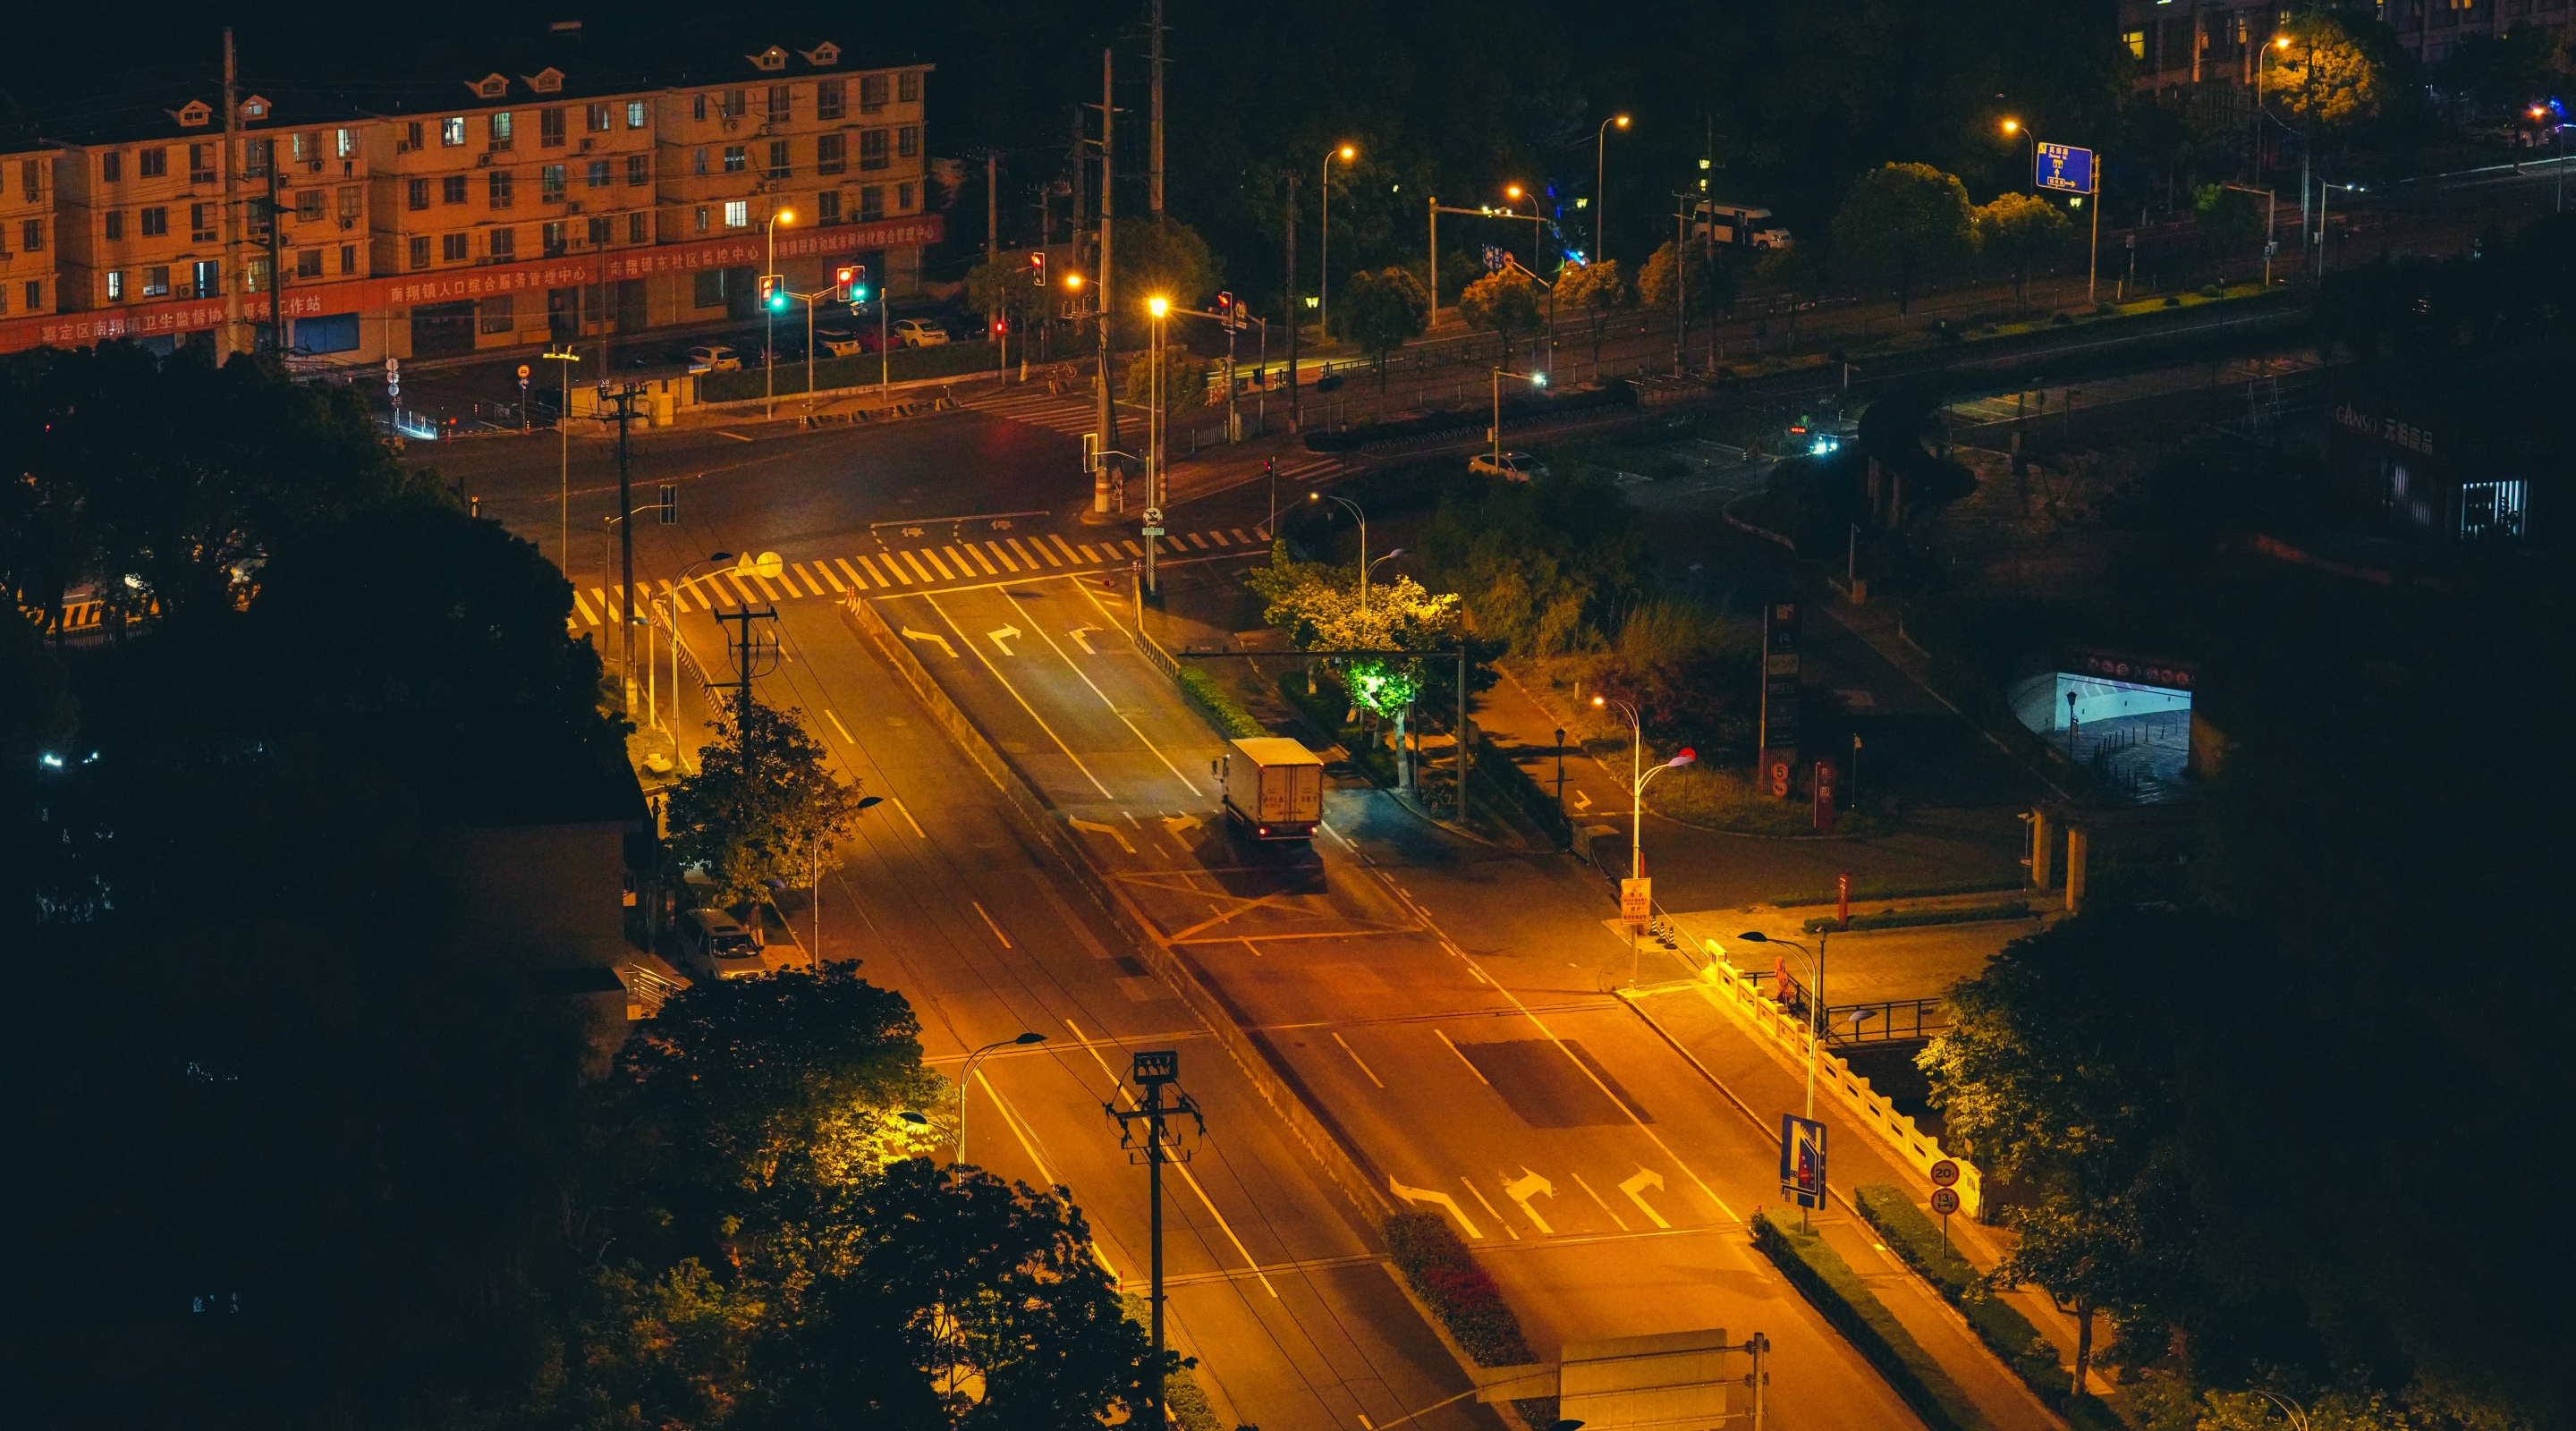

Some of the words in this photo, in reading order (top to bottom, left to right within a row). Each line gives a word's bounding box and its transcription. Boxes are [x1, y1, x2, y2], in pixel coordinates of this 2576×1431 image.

[609, 245, 759, 276] 南翔镇东社区监控中心
[391, 266, 586, 302] 南翔镇人口综合服务管理中心
[42, 294, 321, 342] 嘉定区南翔镇卫生监督协服务作站
[2335, 402, 2377, 435] GANSO
[1776, 766, 1784, 777] 5
